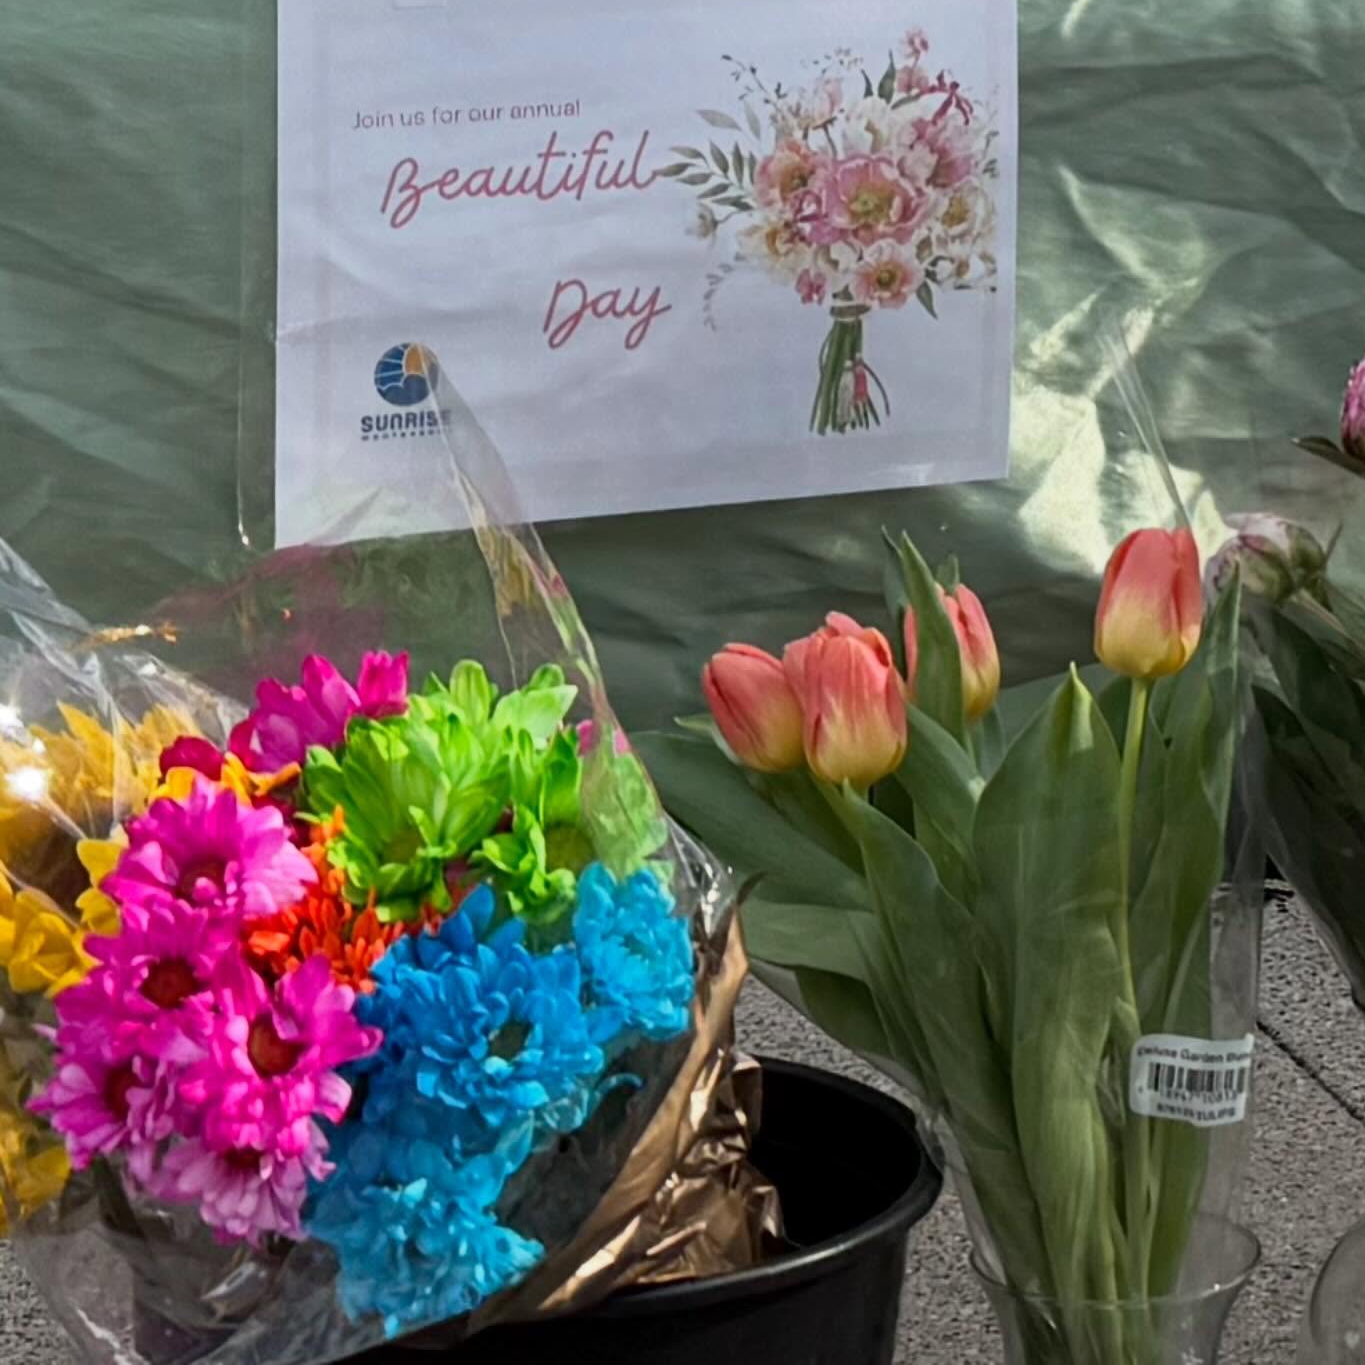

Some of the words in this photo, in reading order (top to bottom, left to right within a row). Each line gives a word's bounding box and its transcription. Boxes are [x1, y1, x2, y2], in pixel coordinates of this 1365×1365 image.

[352, 110, 394, 130] Join
[401, 112, 425, 127] us
[432, 106, 461, 125] for
[468, 106, 504, 122] our
[510, 99, 581, 120] annual
[380, 129, 657, 229] Beautiful
[543, 278, 672, 350] Day
